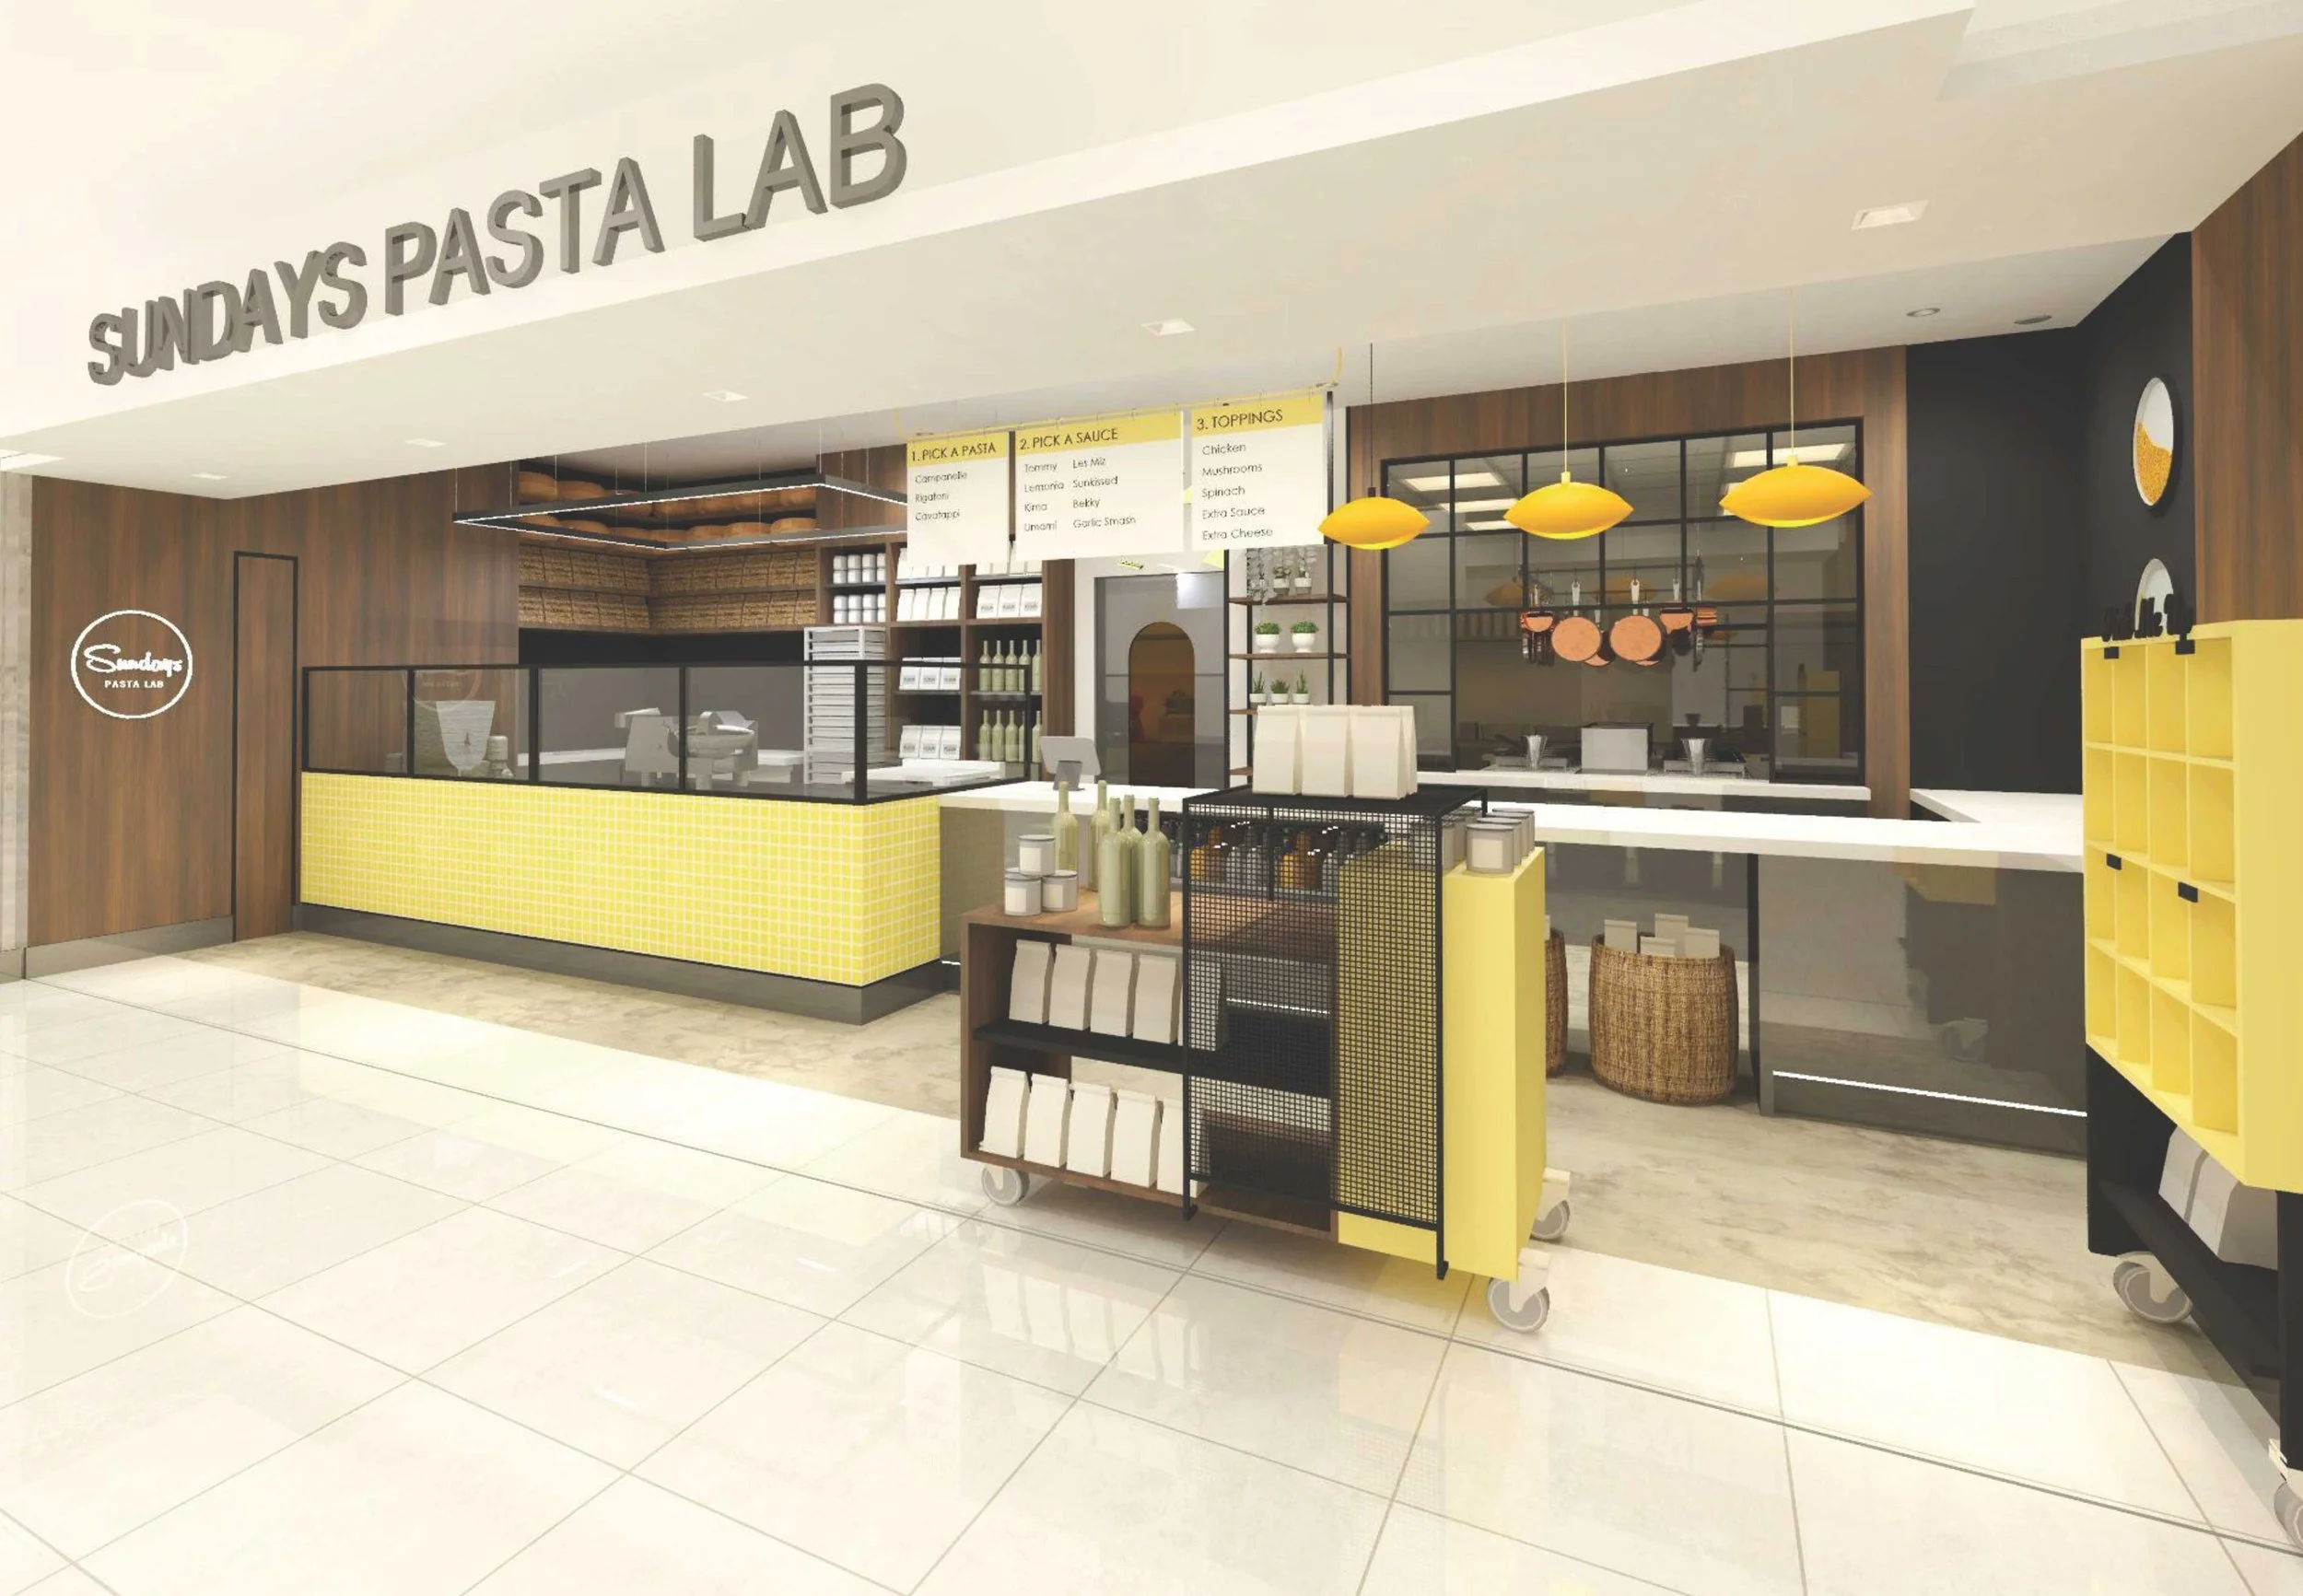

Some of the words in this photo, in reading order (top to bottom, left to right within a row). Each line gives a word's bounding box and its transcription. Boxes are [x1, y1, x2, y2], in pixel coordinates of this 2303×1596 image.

[88, 241, 368, 386] SUNDAYS
[385, 157, 665, 316] PASTA
[693, 83, 907, 241] LAB
[1197, 418, 1209, 430] 3.
[1212, 409, 1283, 428] TOPPINGS
[1020, 438, 1030, 450] 2.
[1033, 435, 1060, 449] PICK
[1064, 434, 1073, 445] A
[1076, 428, 1118, 443] SAUCE
[912, 450, 920, 461] 1.
[922, 448, 947, 460] PICK
[951, 448, 959, 458] A
[962, 442, 997, 456] PASTA
[1202, 443, 1246, 455] Chicken
[1024, 462, 1058, 473] Tommy
[1072, 460, 1088, 469] Les
[1202, 464, 1262, 476] Mushrooms
[1072, 476, 1118, 488] Sunkissed
[1202, 485, 1245, 499] Spinach
[915, 493, 949, 504] Rigatoni
[1072, 498, 1101, 509] Bekky
[915, 509, 960, 521] Cavatappi
[1202, 508, 1228, 519] Extra
[1231, 507, 1265, 518] Sauce
[1024, 520, 1058, 531] Umami
[1072, 518, 1102, 529] Garlic
[1104, 516, 1136, 527] Smash
[1202, 530, 1227, 541] Extra
[1231, 528, 1273, 539] Cheese
[84, 644, 183, 678] Sundays
[104, 680, 140, 689] PASTA
[144, 680, 164, 689] LAB
